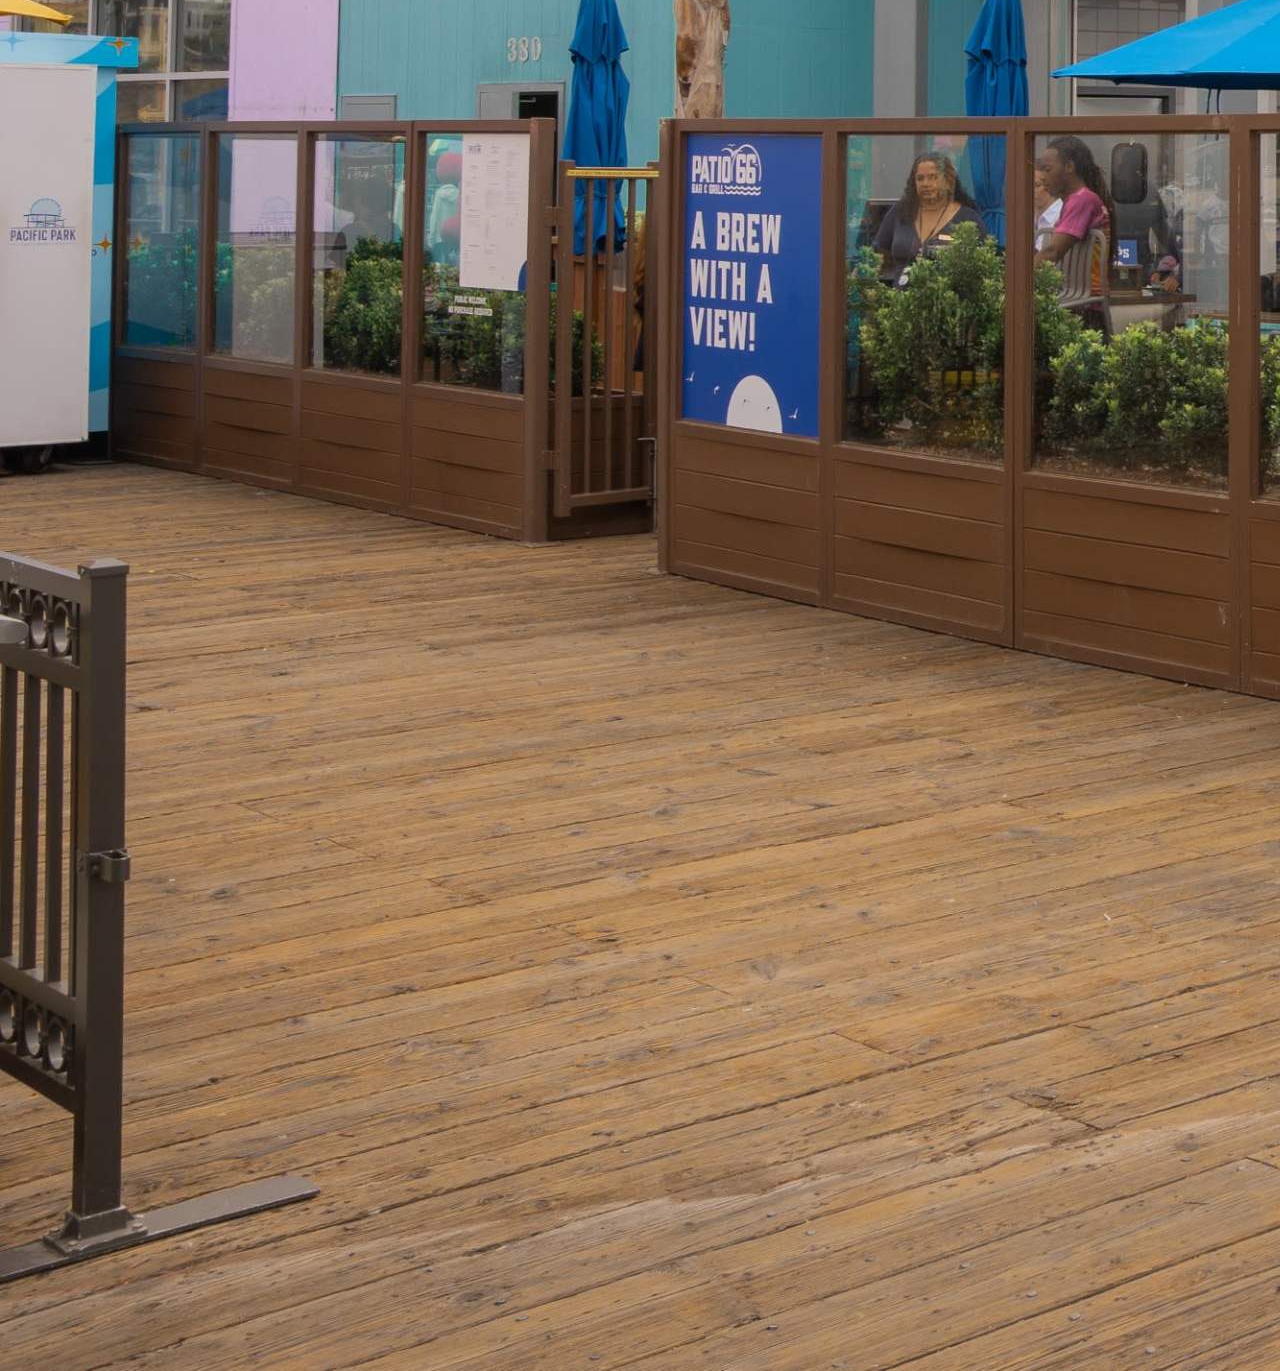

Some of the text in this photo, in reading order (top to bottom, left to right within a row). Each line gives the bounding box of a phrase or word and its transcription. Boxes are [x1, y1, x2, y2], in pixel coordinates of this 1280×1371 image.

[507, 36, 541, 62] 380
[691, 154, 757, 184] PATIO 66
[10, 229, 76, 241] PACIFIC PARK
[690, 211, 782, 254] A BREW
[690, 259, 773, 304] WITH A
[689, 306, 756, 352] VIEW!
